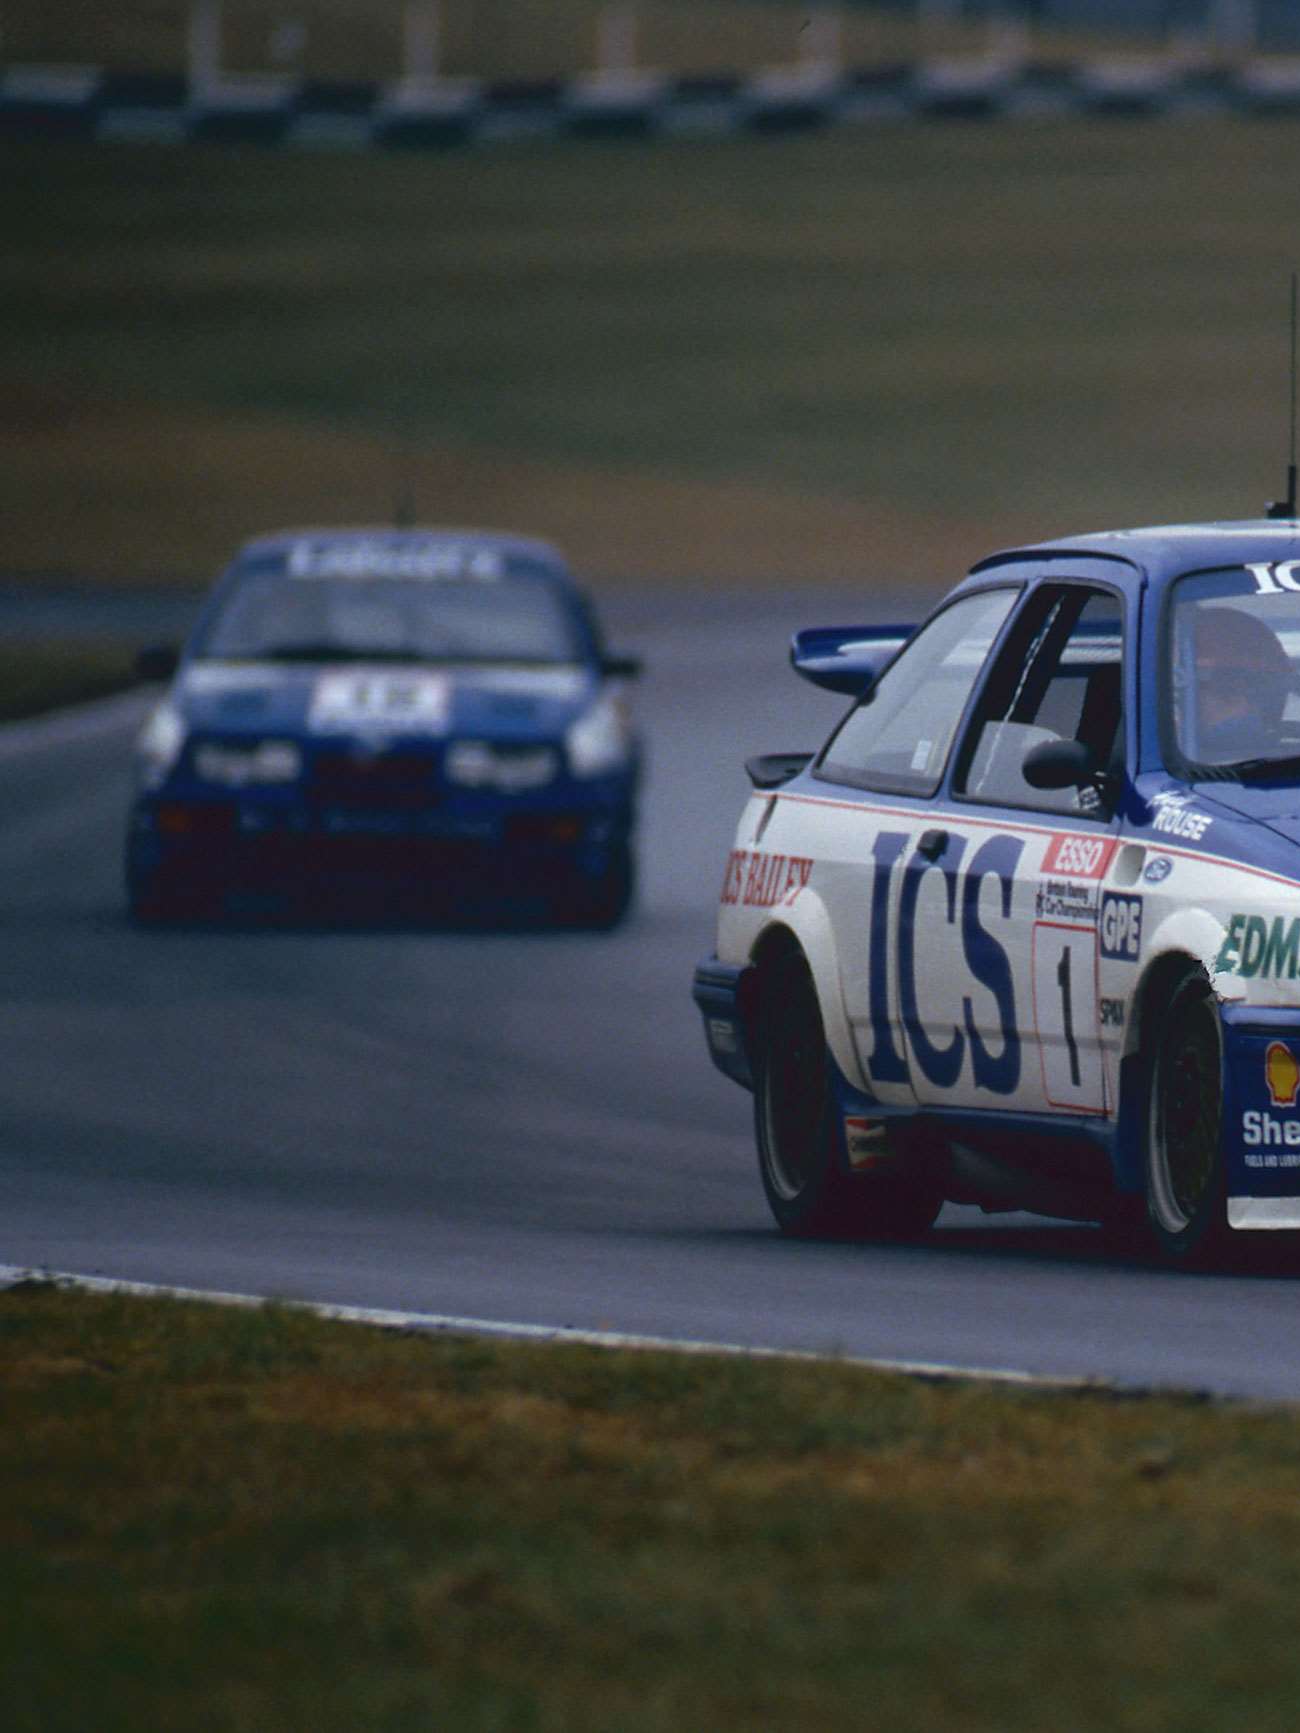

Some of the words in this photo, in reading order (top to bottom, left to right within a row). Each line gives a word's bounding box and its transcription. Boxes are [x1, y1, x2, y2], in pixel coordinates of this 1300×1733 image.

[1152, 806, 1213, 840] ROUSE
[1055, 837, 1105, 874] ESSO
[1102, 899, 1141, 954] GPE
[867, 830, 1026, 1096] ICS
[1057, 946, 1082, 1086] 1
